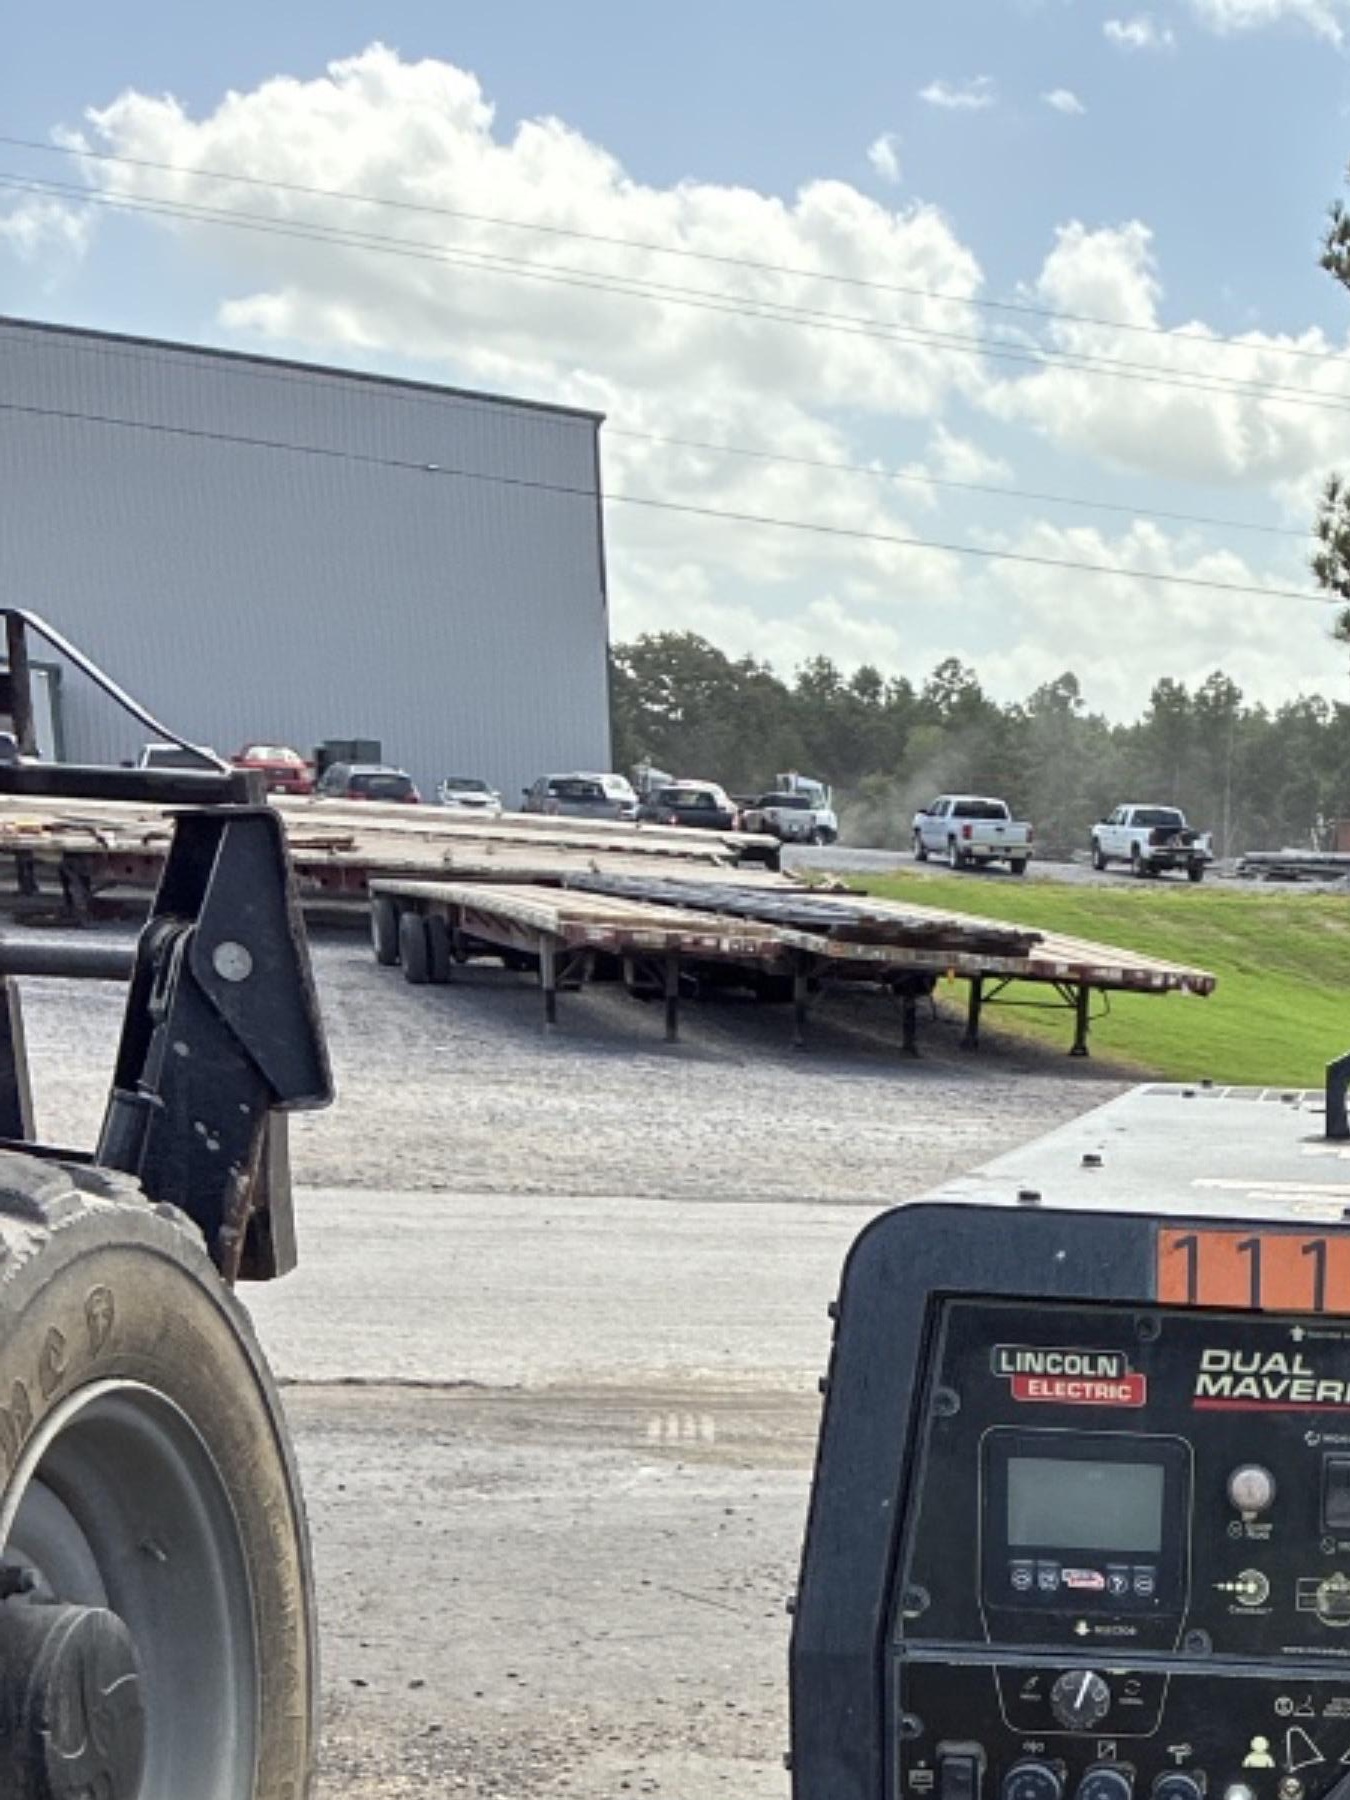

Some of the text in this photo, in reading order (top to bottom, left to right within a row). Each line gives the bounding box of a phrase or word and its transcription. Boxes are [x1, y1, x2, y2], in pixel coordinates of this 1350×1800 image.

[1000, 1350, 1119, 1379] LINCOLN
[1200, 1349, 1315, 1376] DUAL
[1027, 1378, 1134, 1401] ELECTRIC
